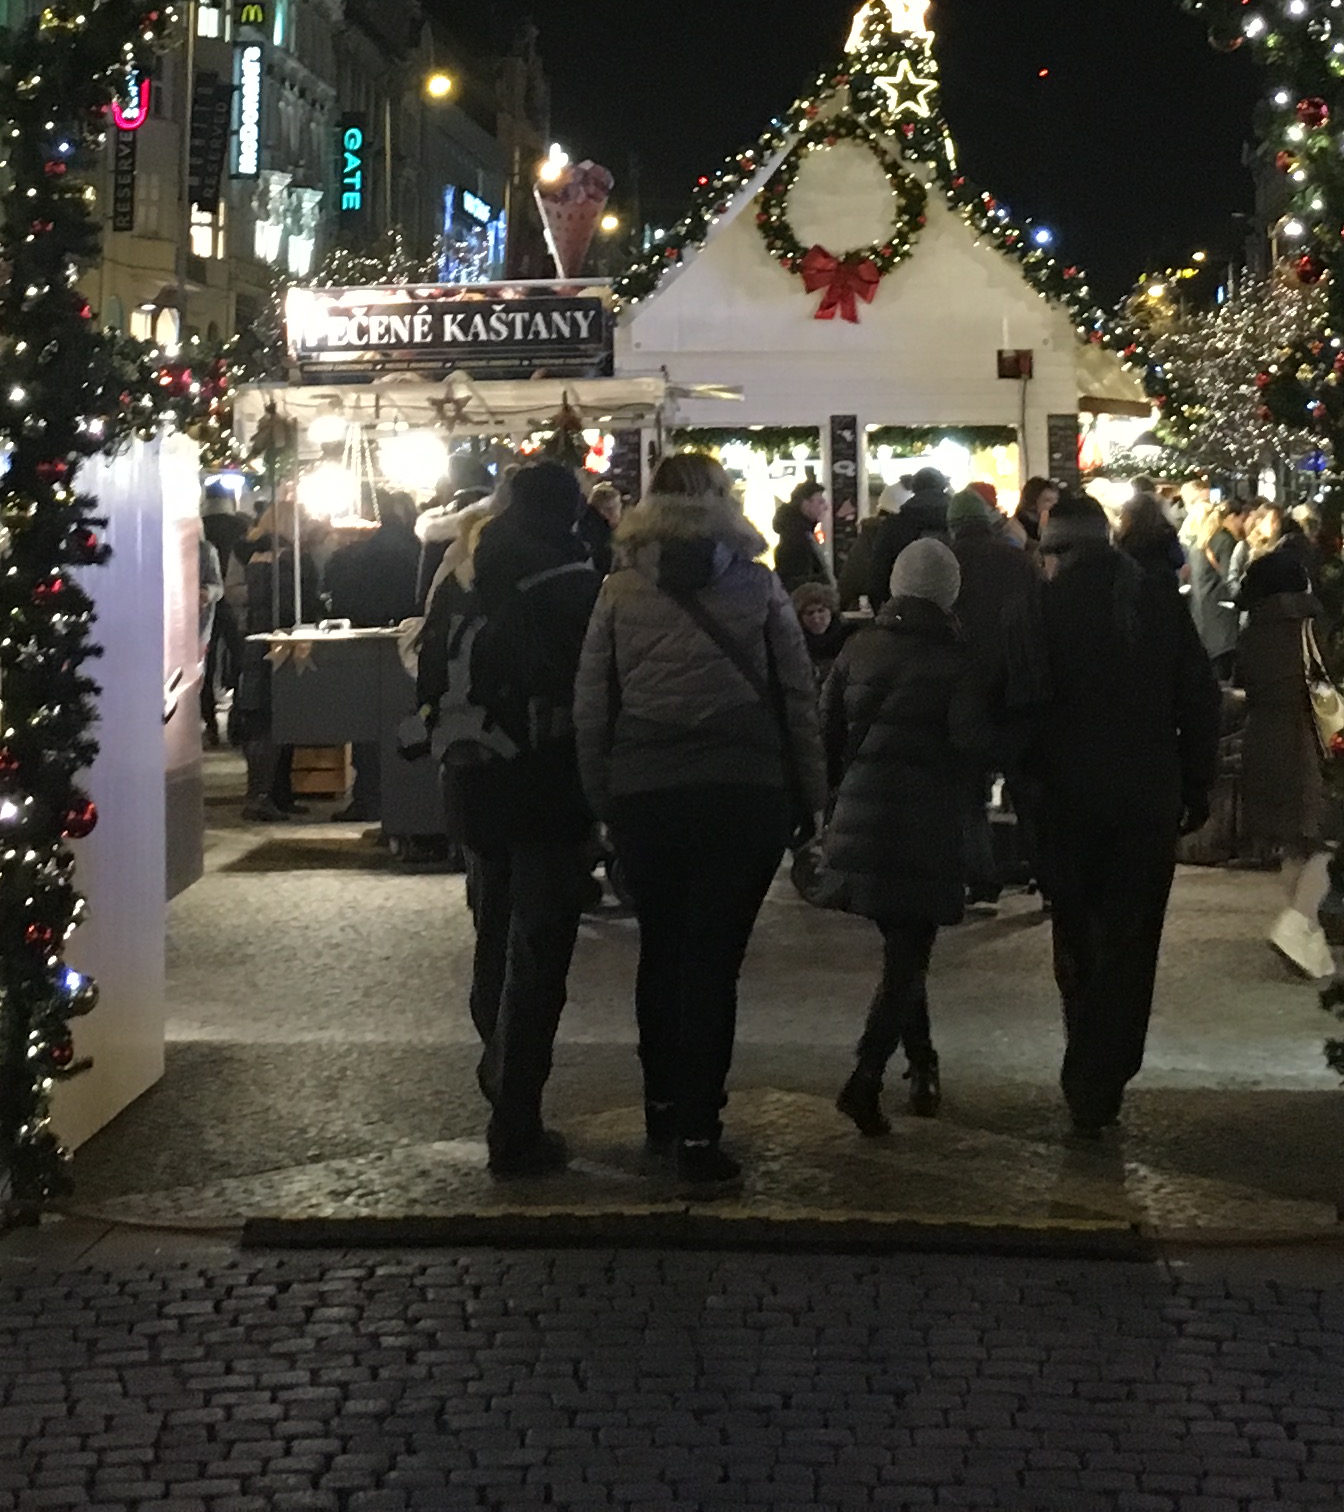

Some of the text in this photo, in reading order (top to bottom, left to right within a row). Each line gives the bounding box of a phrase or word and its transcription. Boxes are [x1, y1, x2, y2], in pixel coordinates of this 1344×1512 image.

[116, 130, 134, 228] RESERVE
[341, 127, 363, 211] GATE
[442, 303, 597, 343] KAŠTANY
